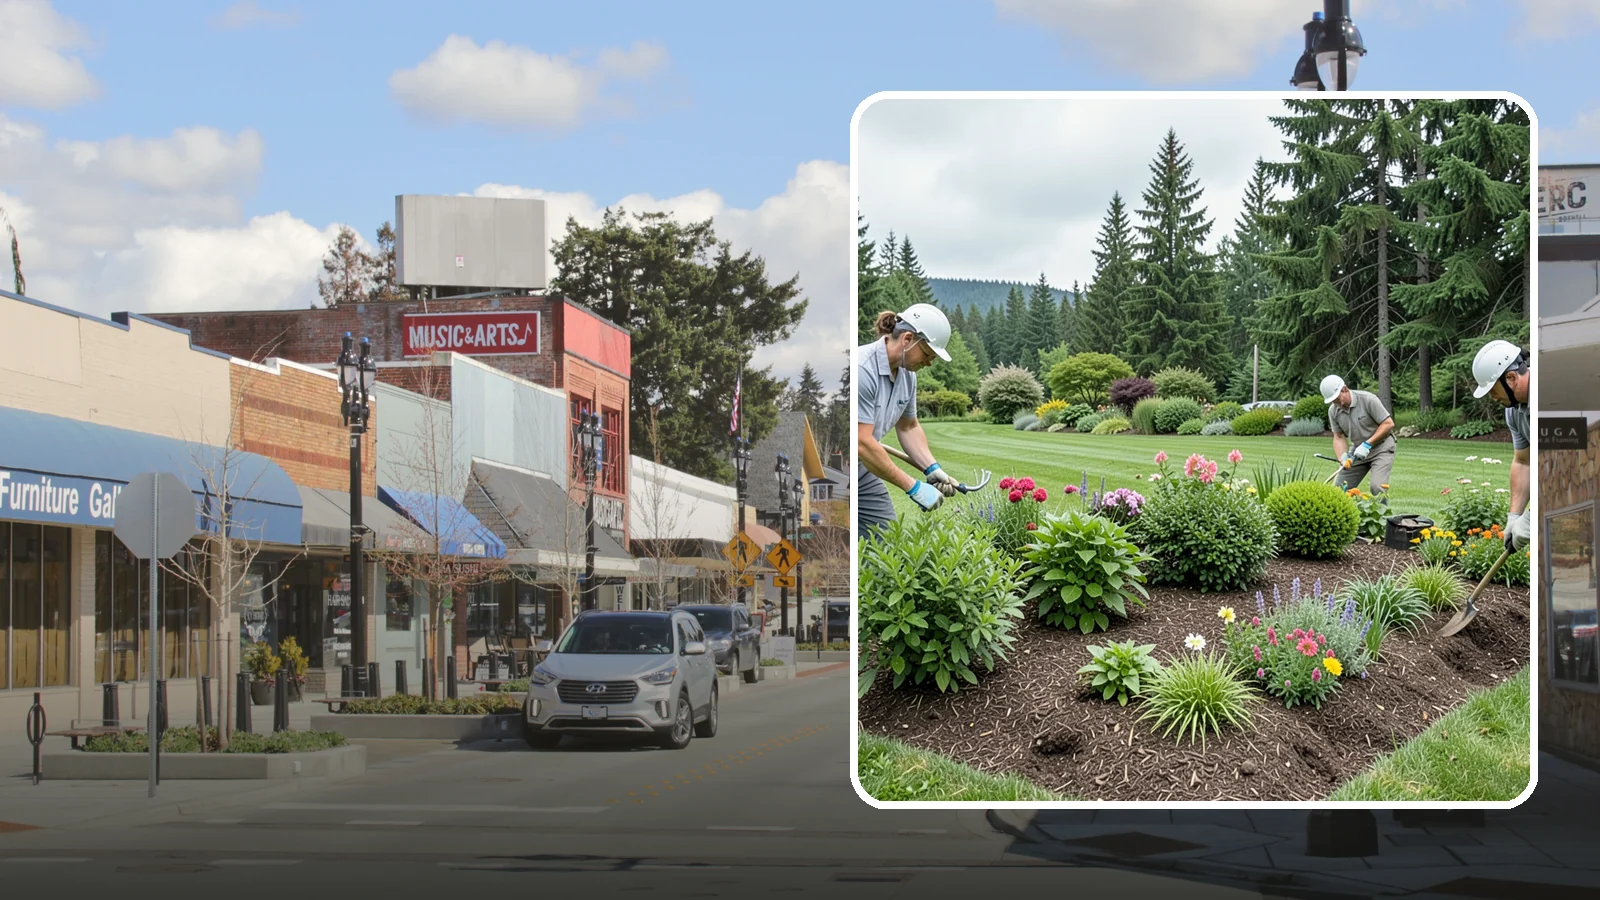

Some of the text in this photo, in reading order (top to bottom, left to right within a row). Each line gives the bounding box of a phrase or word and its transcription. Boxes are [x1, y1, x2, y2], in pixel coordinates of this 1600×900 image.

[409, 323, 519, 348] MUSIC&ARTS
[1540, 428, 1577, 436] UGA
[0, 472, 121, 519] Furniture Gal
[453, 563, 479, 574] SUSHI
